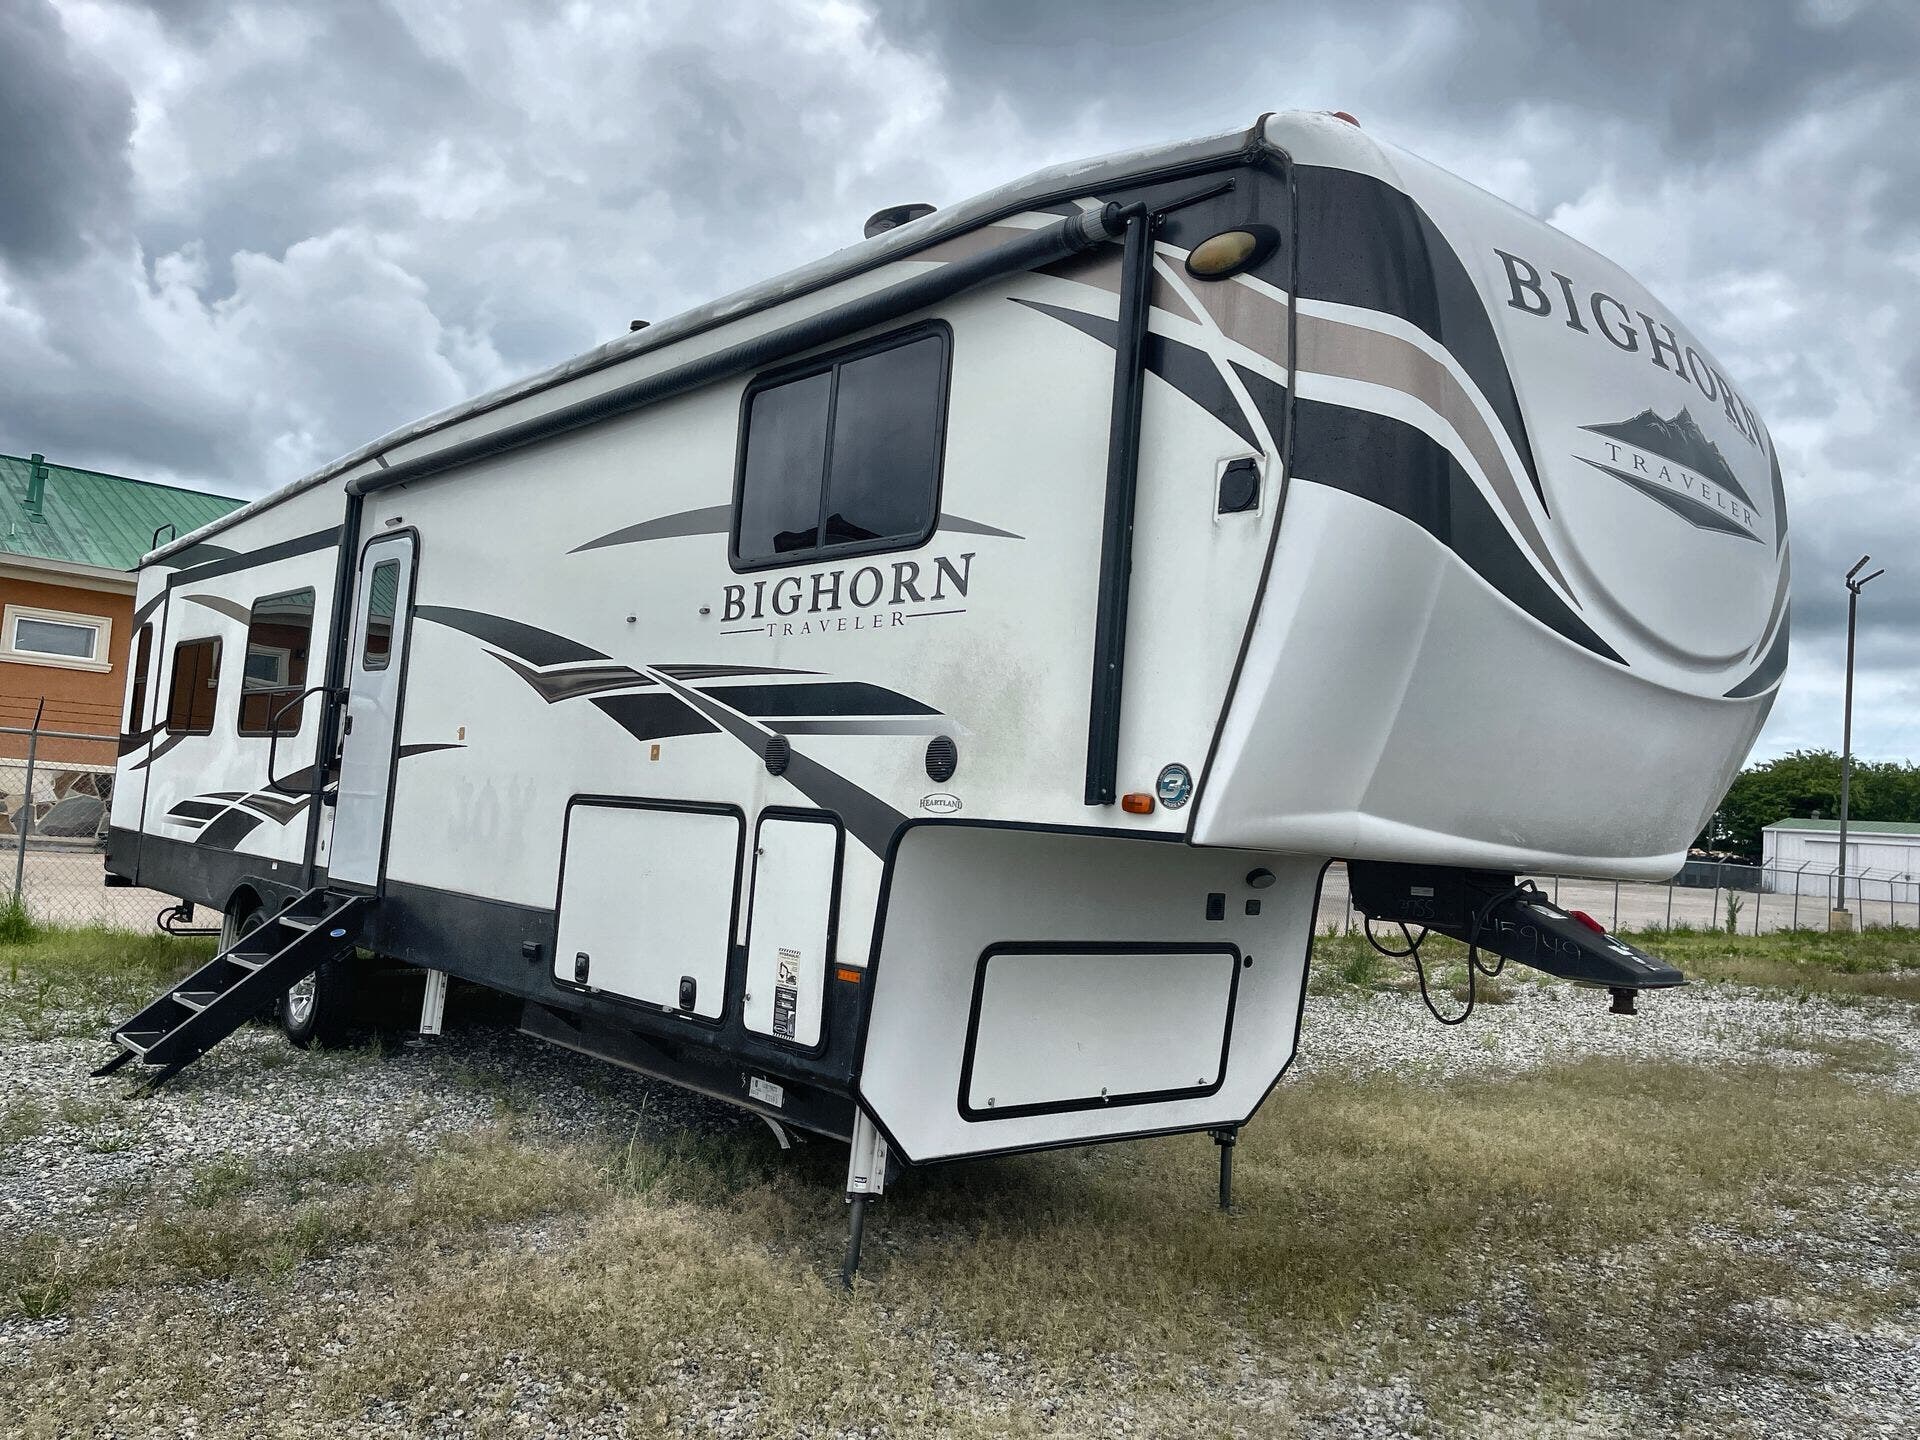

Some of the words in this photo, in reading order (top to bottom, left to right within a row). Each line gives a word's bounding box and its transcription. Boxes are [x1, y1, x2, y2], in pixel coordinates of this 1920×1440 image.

[1492, 247, 1766, 457] BIGHORN
[1604, 441, 1753, 528] TRAVELER
[720, 552, 976, 623] BIGHORN
[767, 611, 905, 638] TRAVELER
[920, 799, 962, 809] HEARTLAND
